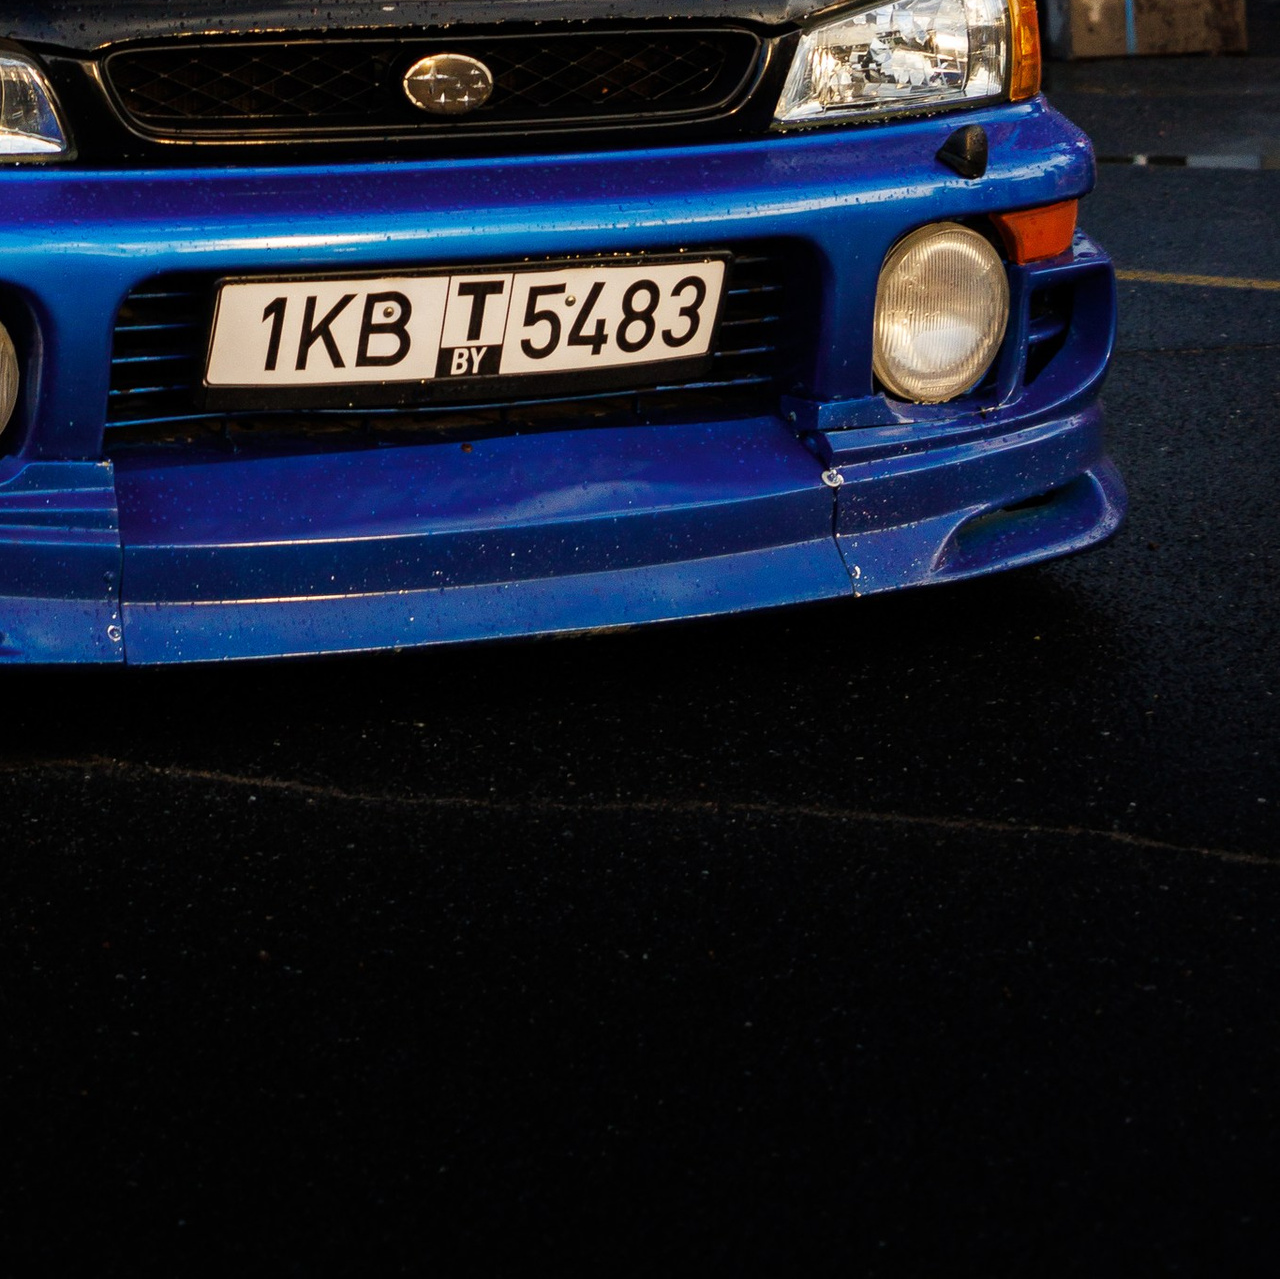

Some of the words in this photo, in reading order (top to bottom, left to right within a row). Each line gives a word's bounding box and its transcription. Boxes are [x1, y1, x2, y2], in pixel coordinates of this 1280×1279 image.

[261, 292, 412, 371] 1KB
[457, 281, 504, 341] T
[520, 276, 708, 360] 5483
[450, 346, 488, 376] BY
